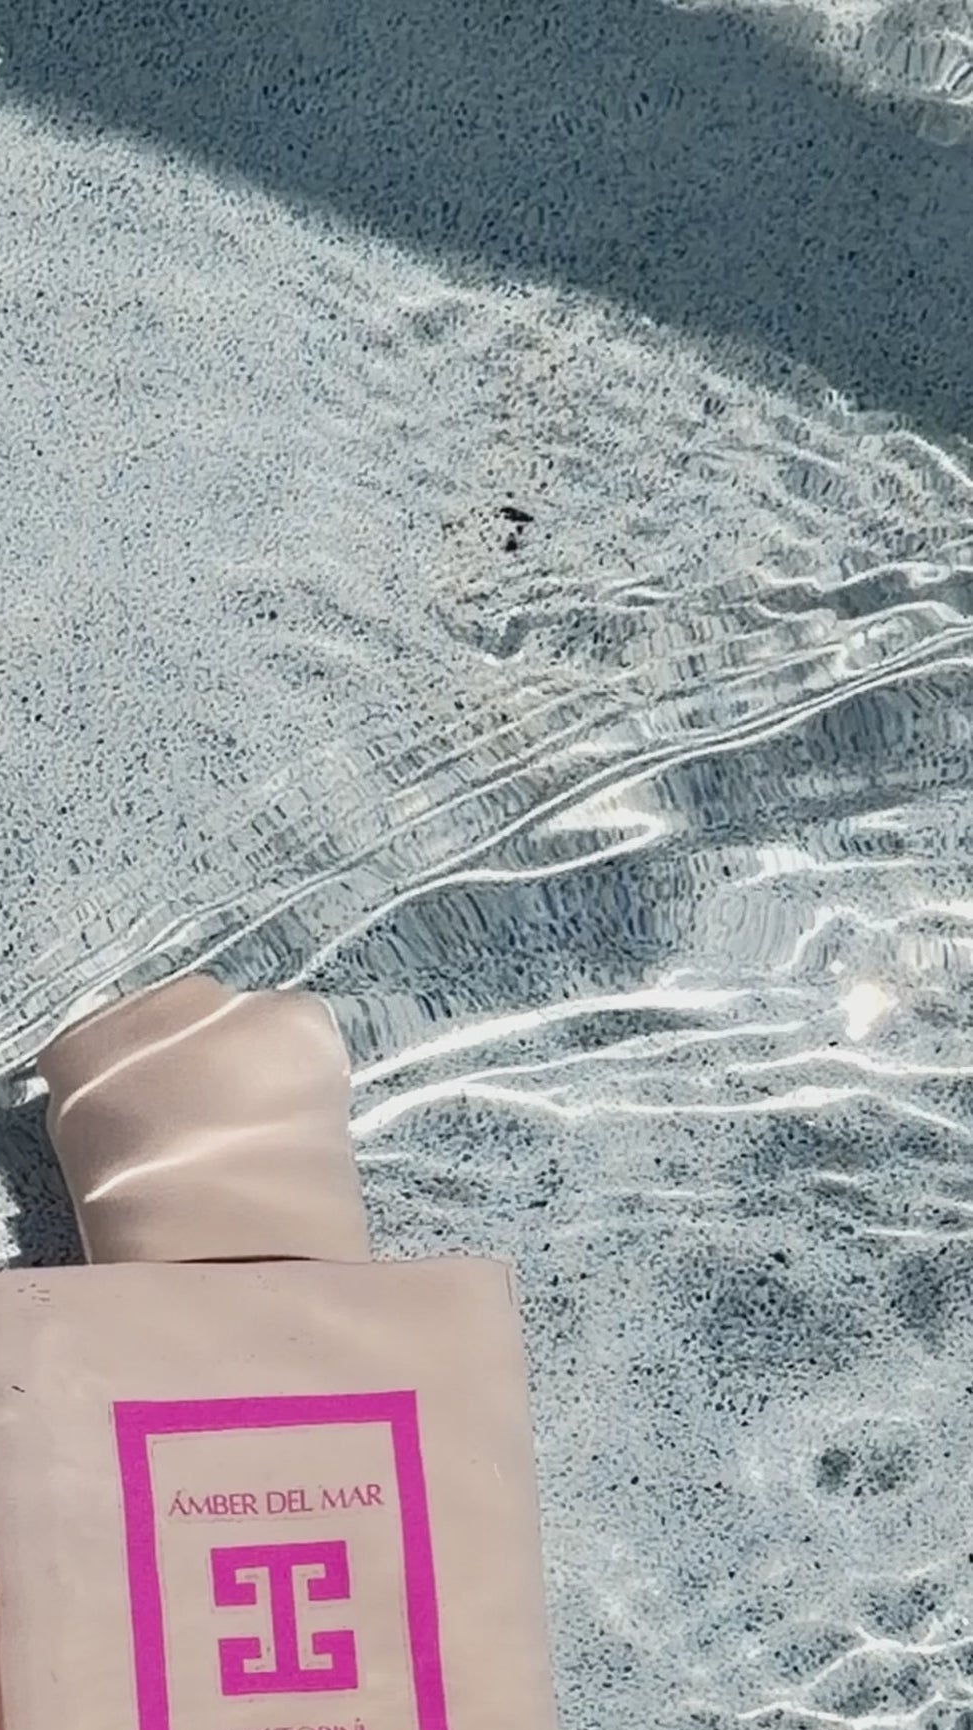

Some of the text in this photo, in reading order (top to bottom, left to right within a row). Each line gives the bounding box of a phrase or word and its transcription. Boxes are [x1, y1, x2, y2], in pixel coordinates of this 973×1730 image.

[168, 1483, 385, 1517] ÁMBER DEL MAR
